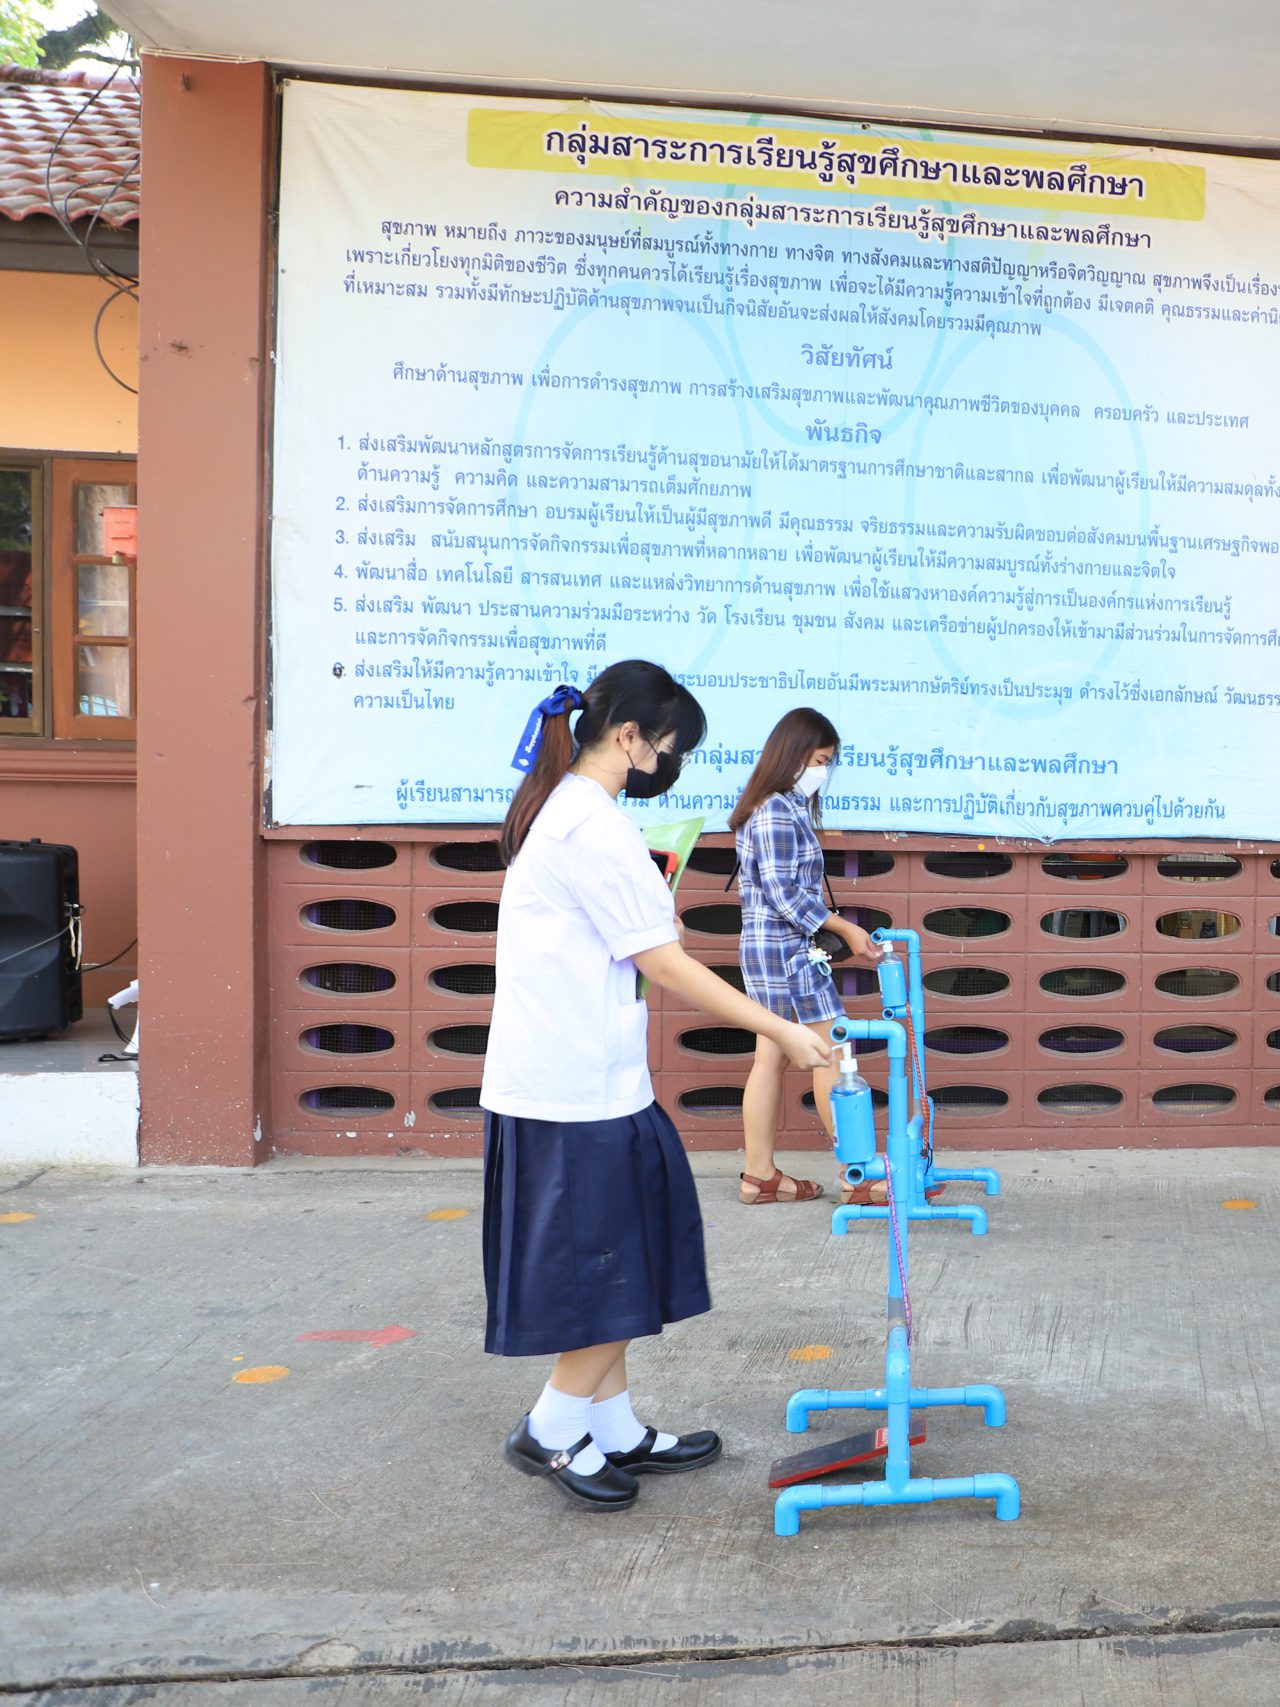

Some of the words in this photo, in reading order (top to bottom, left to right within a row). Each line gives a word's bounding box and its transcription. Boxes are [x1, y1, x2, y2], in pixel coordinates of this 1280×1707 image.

[545, 124, 1146, 199] กลุ่มสาระการเรียนรู้สุขศึกษาและพลศึกษา
[554, 186, 1152, 249] ความสำคัญของกลุ่มสาระการเรียนรู้สุขศึกษาและพลศึกษา
[380, 219, 437, 236] สุขภาพ
[445, 222, 508, 242] หมายถึง
[514, 226, 778, 259] ภาวะของมนุษย์ที่สมบูรณ์ทั้งทางกาย
[785, 247, 835, 263] ทางจิต
[842, 247, 1146, 288] ทางสังคมและทางสติปัญญาหรือจิตวิญญาณ
[343, 271, 428, 298] ที่เหมาะสม
[346, 243, 567, 277] เพราะเกี่ยวโยงทุกมิติของชีวิต
[575, 252, 822, 296] ซึ่งทุกคนควรได้เรียนรู้เรื่องสุขภาพ
[830, 271, 1092, 315] เพื่อจะได้มีความรู้ความเข้าใจที่ถูกต้อง
[1098, 294, 1155, 316] มีเจตคติ
[801, 343, 894, 370] วิสัยทัศน์
[393, 360, 524, 390] ศึกษาด้านสุขภาพ
[531, 364, 682, 399] เพื่อการดำรงสุขภาพ
[689, 378, 1081, 422] การสร้างเสริมสุขภาพและพัฒนาคุณภาพชีวิตของบุคคล
[1094, 403, 1160, 424] ครอบครัว
[1166, 410, 1249, 430] และประเทศ
[337, 436, 351, 451] 1.
[805, 419, 883, 445] พันธกิจ
[357, 465, 441, 490] ด้านความรู้
[454, 468, 518, 487] ความคิด
[527, 473, 751, 498] และความสามารถเต็มศักยภาพ
[335, 496, 350, 511] 2.
[357, 493, 538, 519] ส่งเสริมการจัดการศึกษา
[545, 501, 772, 533] อบรมผู้เรียนให้เป็นผู้มีสุขภาพดี
[779, 510, 853, 537] มีคุณธรรม
[335, 530, 350, 545] 3.
[357, 527, 416, 546] ส่งเสริม
[431, 529, 787, 563] สนับสนุนการจัดกิจกรรมเพื่อสุขภาพที่หลากหลาย
[795, 540, 1176, 579] เพื่อพัฒนาผู้เรียนให้มีความสมบูรณ์ทั้งร่างกายและจิตใจ
[334, 564, 348, 580] 4.
[355, 557, 428, 582] พัฒนาสื่อ
[436, 562, 513, 585] เทคโนโลยี
[521, 571, 602, 588] สารสนเทศ
[609, 569, 836, 601] และแหล่งวิทยาการด้านสุขภาพ
[843, 573, 1232, 620] เพื่อใช้แสวงหาองค์ความรู้สู่การเป็นองค์กรแห่งการเรียนรู้
[333, 597, 347, 612] 5.
[355, 593, 414, 614] ส่งเสริม
[421, 593, 471, 616] พัฒนา
[479, 597, 690, 624] ประสานความร่วมมือระหว่าง
[697, 608, 717, 625] วัด
[725, 604, 786, 627] โรงเรียน
[793, 614, 837, 634] ชุมชน
[844, 611, 885, 631] สังคม
[355, 624, 607, 656] และการจัดกิจกรรมเพื่อสุขภาพที่ดี
[353, 688, 455, 710] ความเป็นไทย
[354, 656, 579, 687] ส่งเสริมให้มีความรู้ความเข้าใจ
[1079, 680, 1218, 704] ดำรงไว้ซึ่งเอกลักษณ์
[890, 789, 1226, 824] และการปฏิบัติเกี่ยวกับสุขภาพควบคู่ไปด้วยกัน
